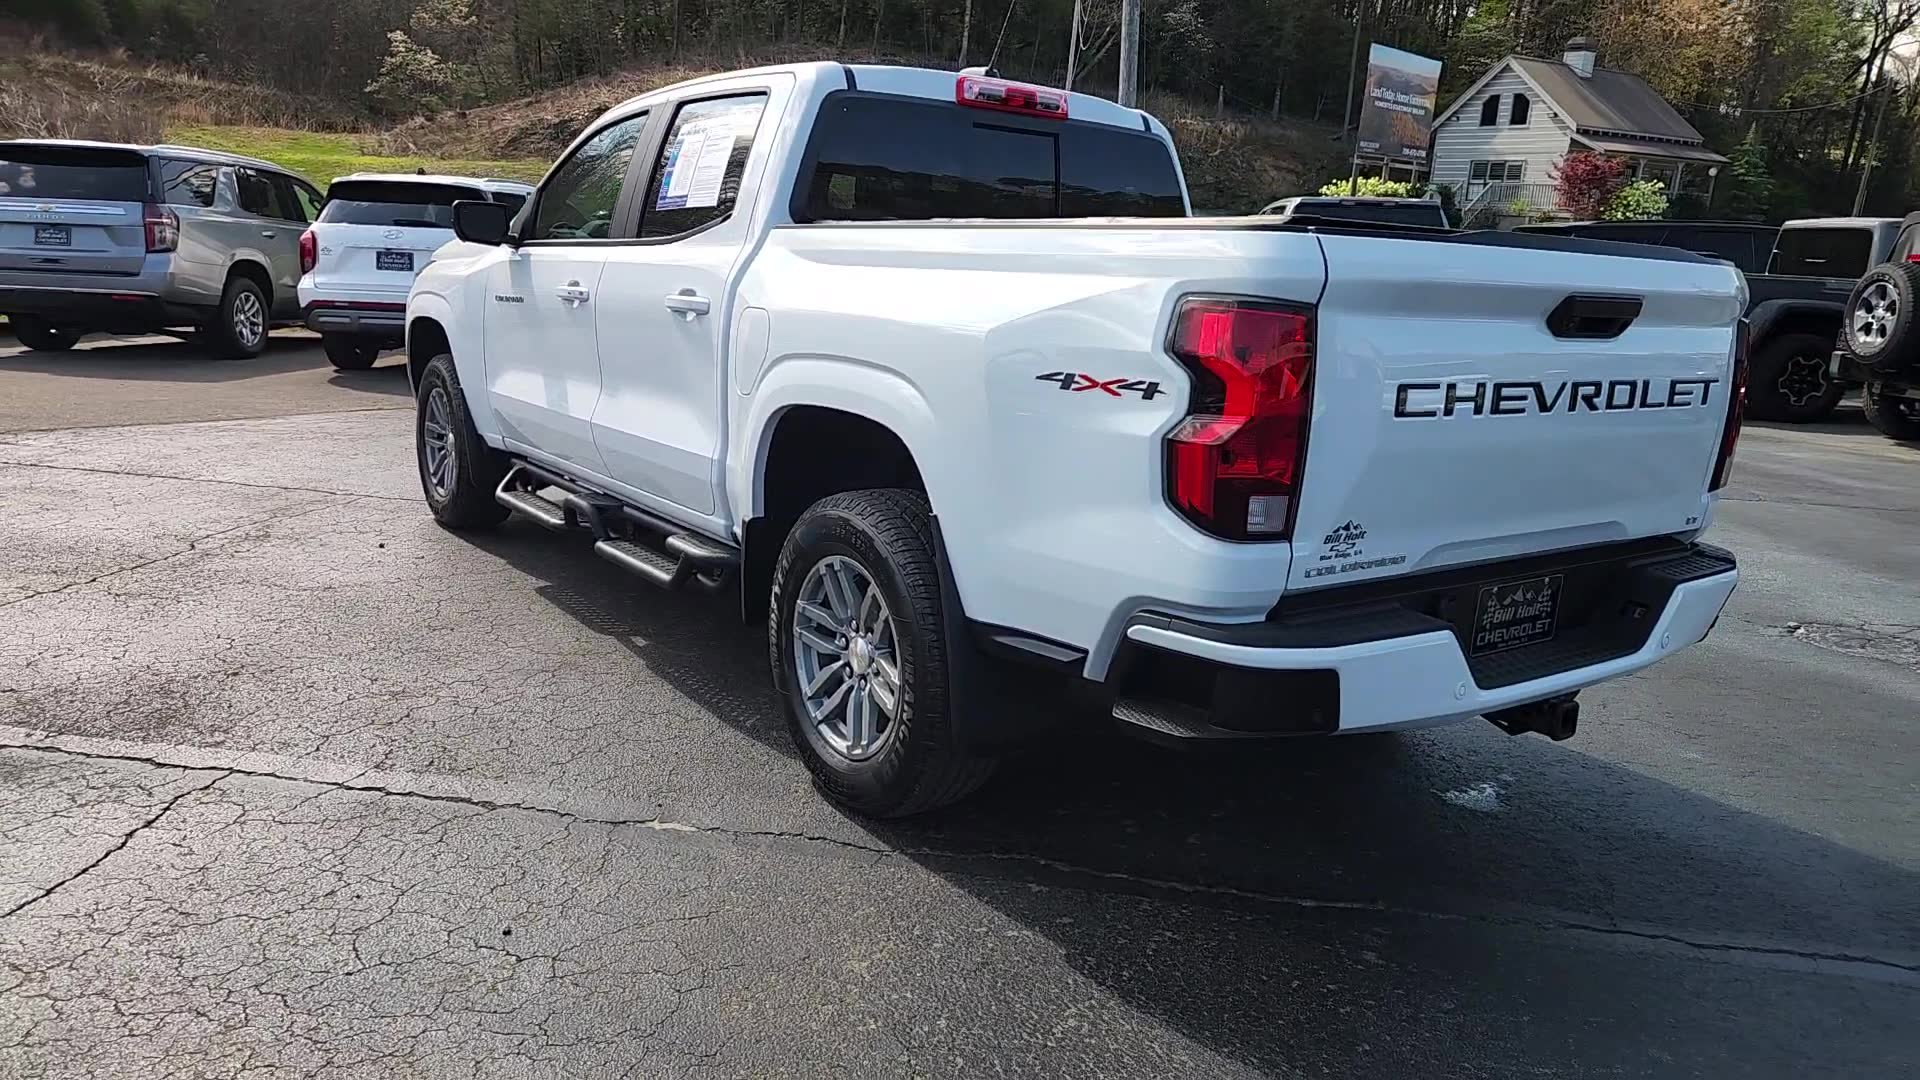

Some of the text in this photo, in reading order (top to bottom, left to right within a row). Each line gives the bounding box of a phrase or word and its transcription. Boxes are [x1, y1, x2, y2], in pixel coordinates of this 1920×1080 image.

[1393, 378, 1720, 418] CHEVROLET
[1323, 530, 1367, 545] Bill Holt
[1493, 603, 1541, 623] Bill Holt
[1477, 619, 1552, 646] CHEVROLET
